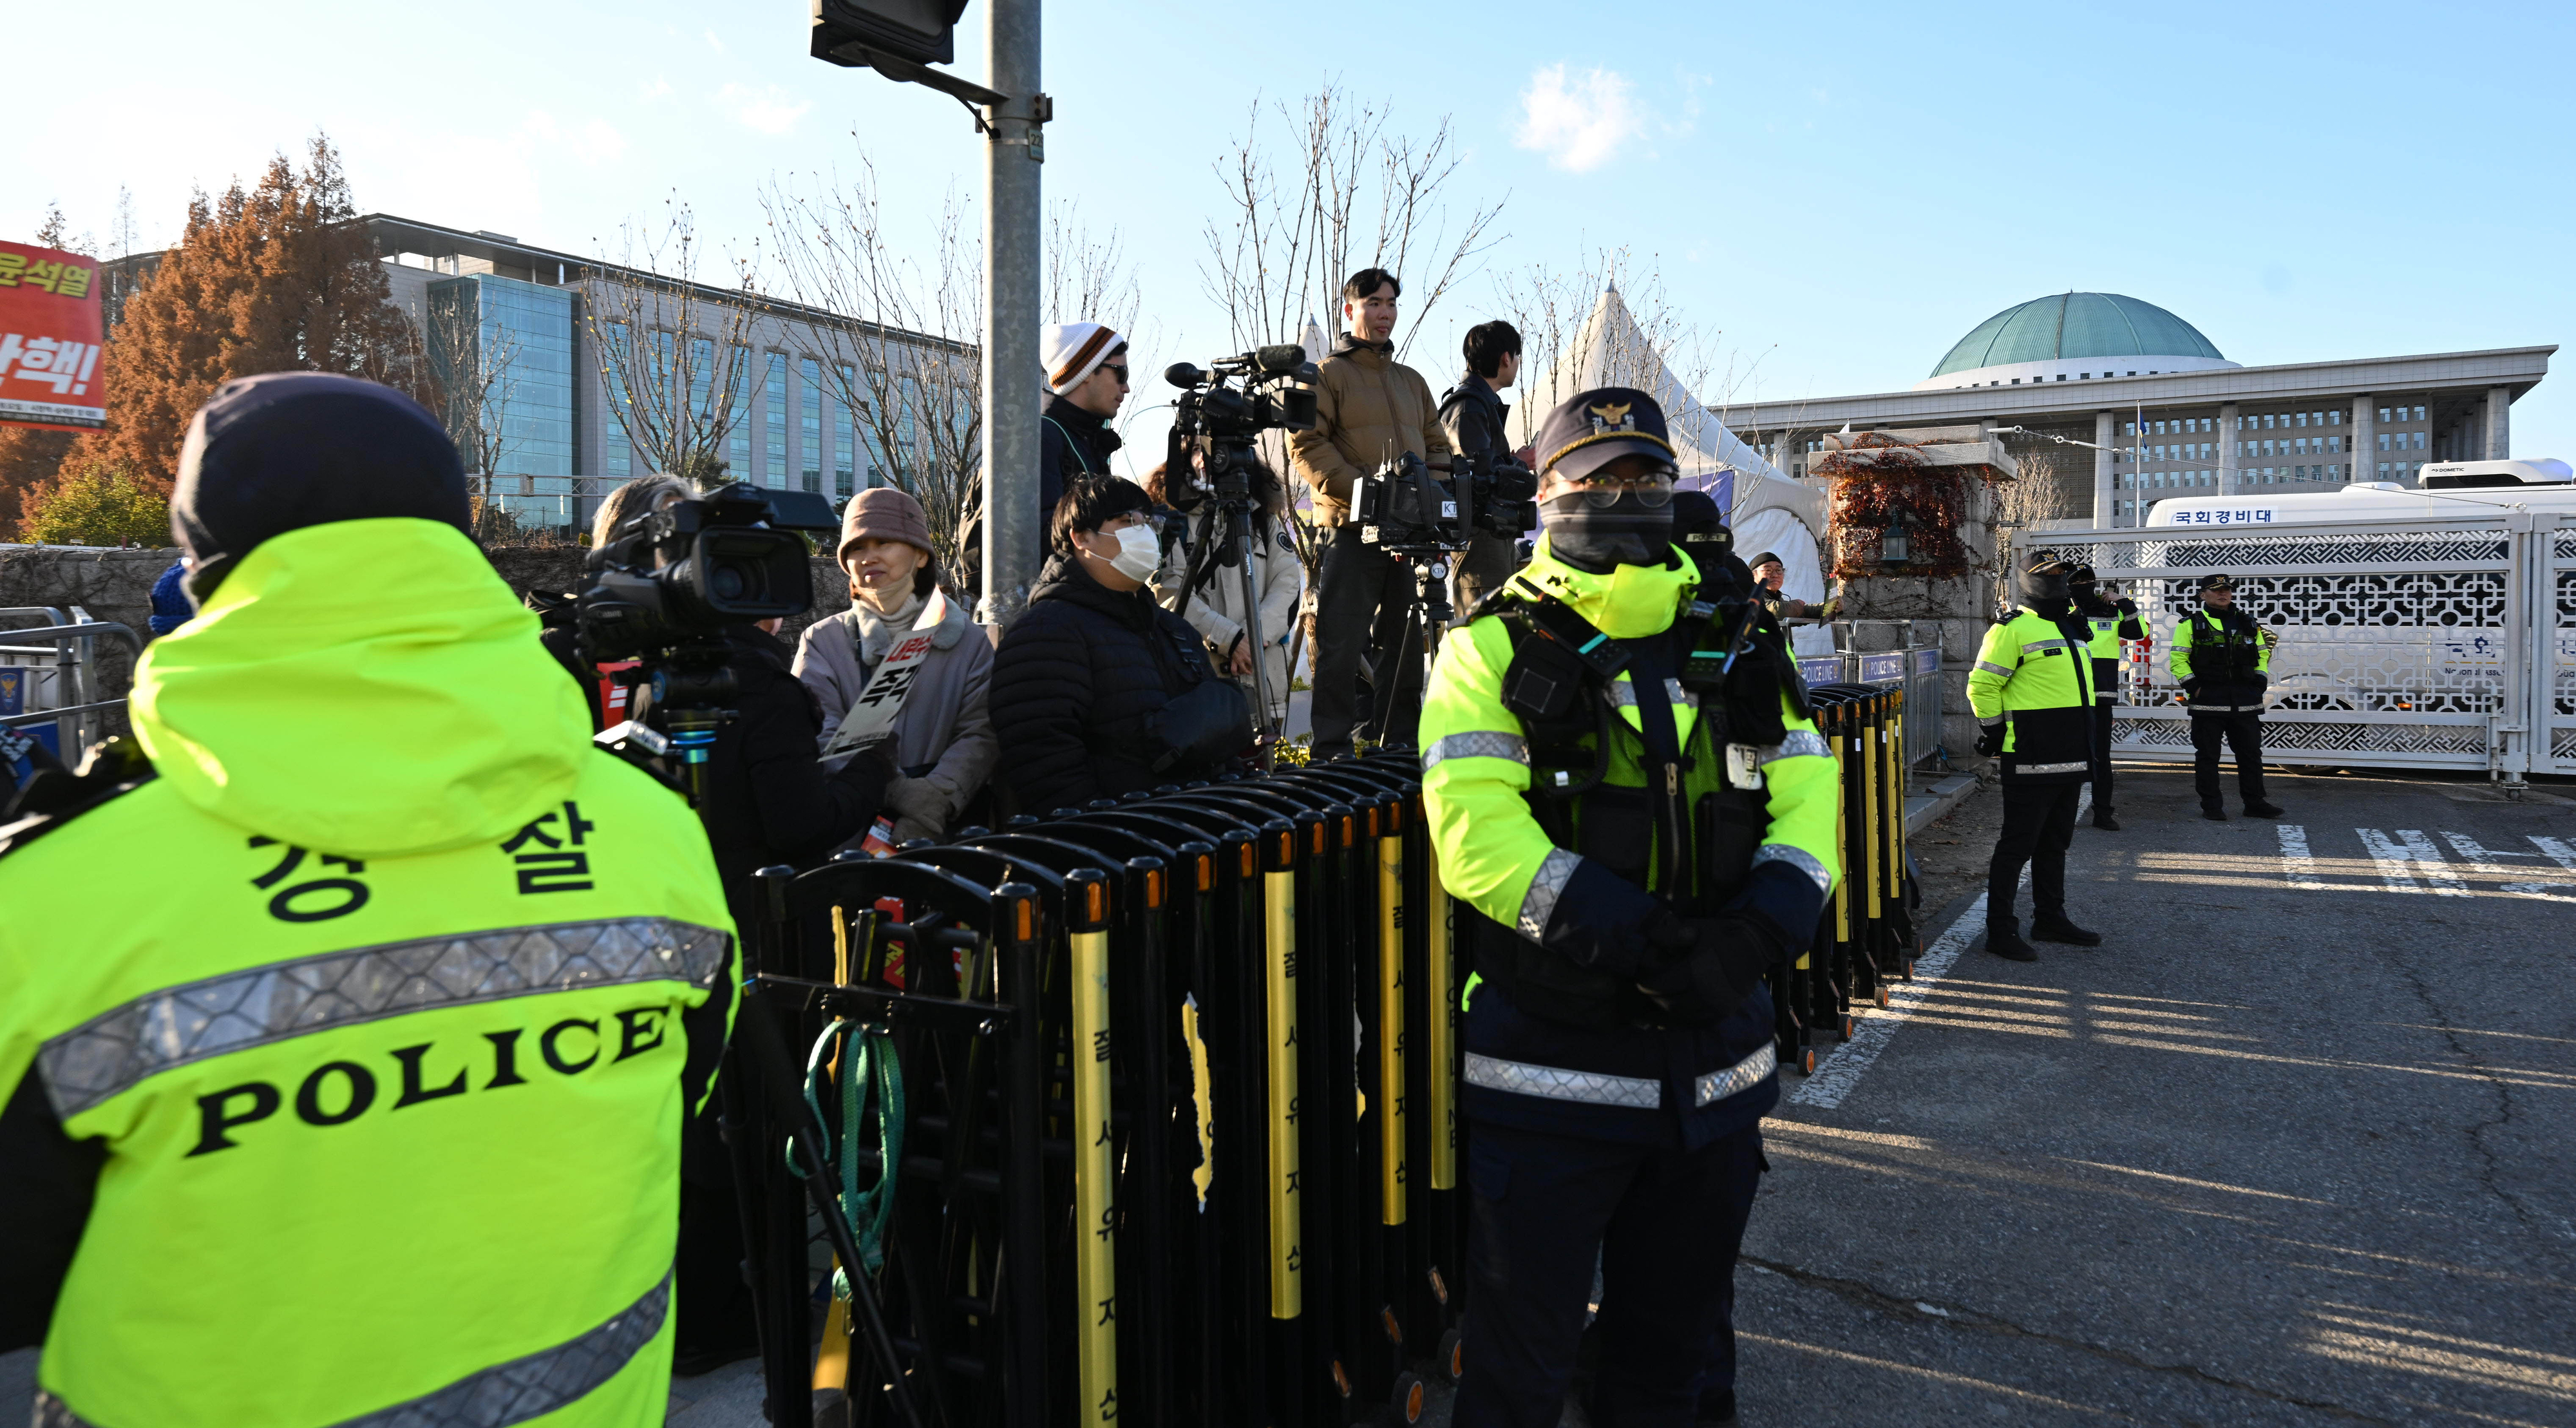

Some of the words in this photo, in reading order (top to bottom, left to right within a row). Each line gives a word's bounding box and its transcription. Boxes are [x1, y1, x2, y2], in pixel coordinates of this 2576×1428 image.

[0, 252, 93, 298] 윤석열
[1444, 503, 1456, 513] KT
[2175, 510, 2271, 524] 국회경비대
[1804, 665, 1822, 683] POLICE
[1823, 665, 1832, 681] LINE
[1871, 660, 1887, 675] POLICE
[1888, 660, 1897, 674] LINE
[182, 1005, 670, 1159] POLICE
